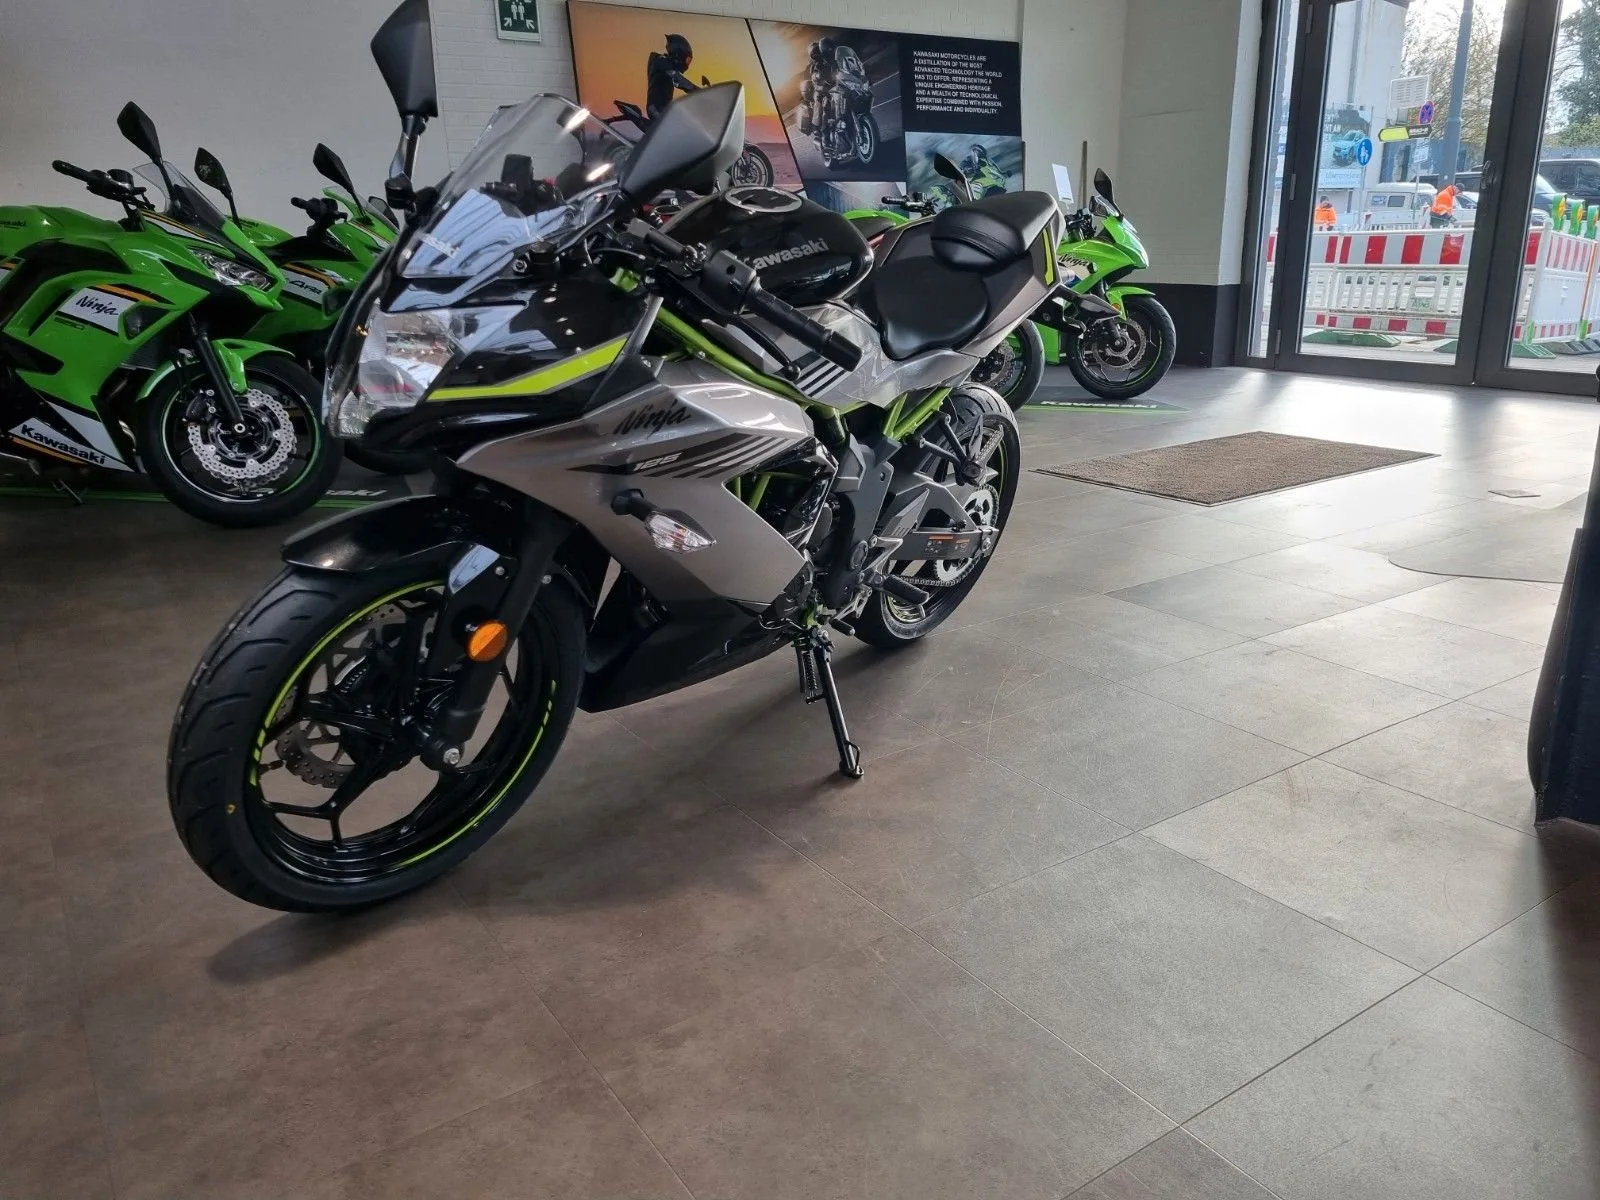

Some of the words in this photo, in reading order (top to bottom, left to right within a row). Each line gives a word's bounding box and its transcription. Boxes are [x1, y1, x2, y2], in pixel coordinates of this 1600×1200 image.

[913, 50, 940, 58] KAWASAKI
[940, 52, 976, 61] MOTORCYCLES
[952, 76, 987, 84] REPRESENTING
[916, 104, 953, 112] PERFORMANCE
[1058, 254, 1088, 267] Ninja
[75, 295, 119, 316] Ninja
[613, 398, 692, 440] Ninja
[20, 424, 106, 465] Kawasaki
